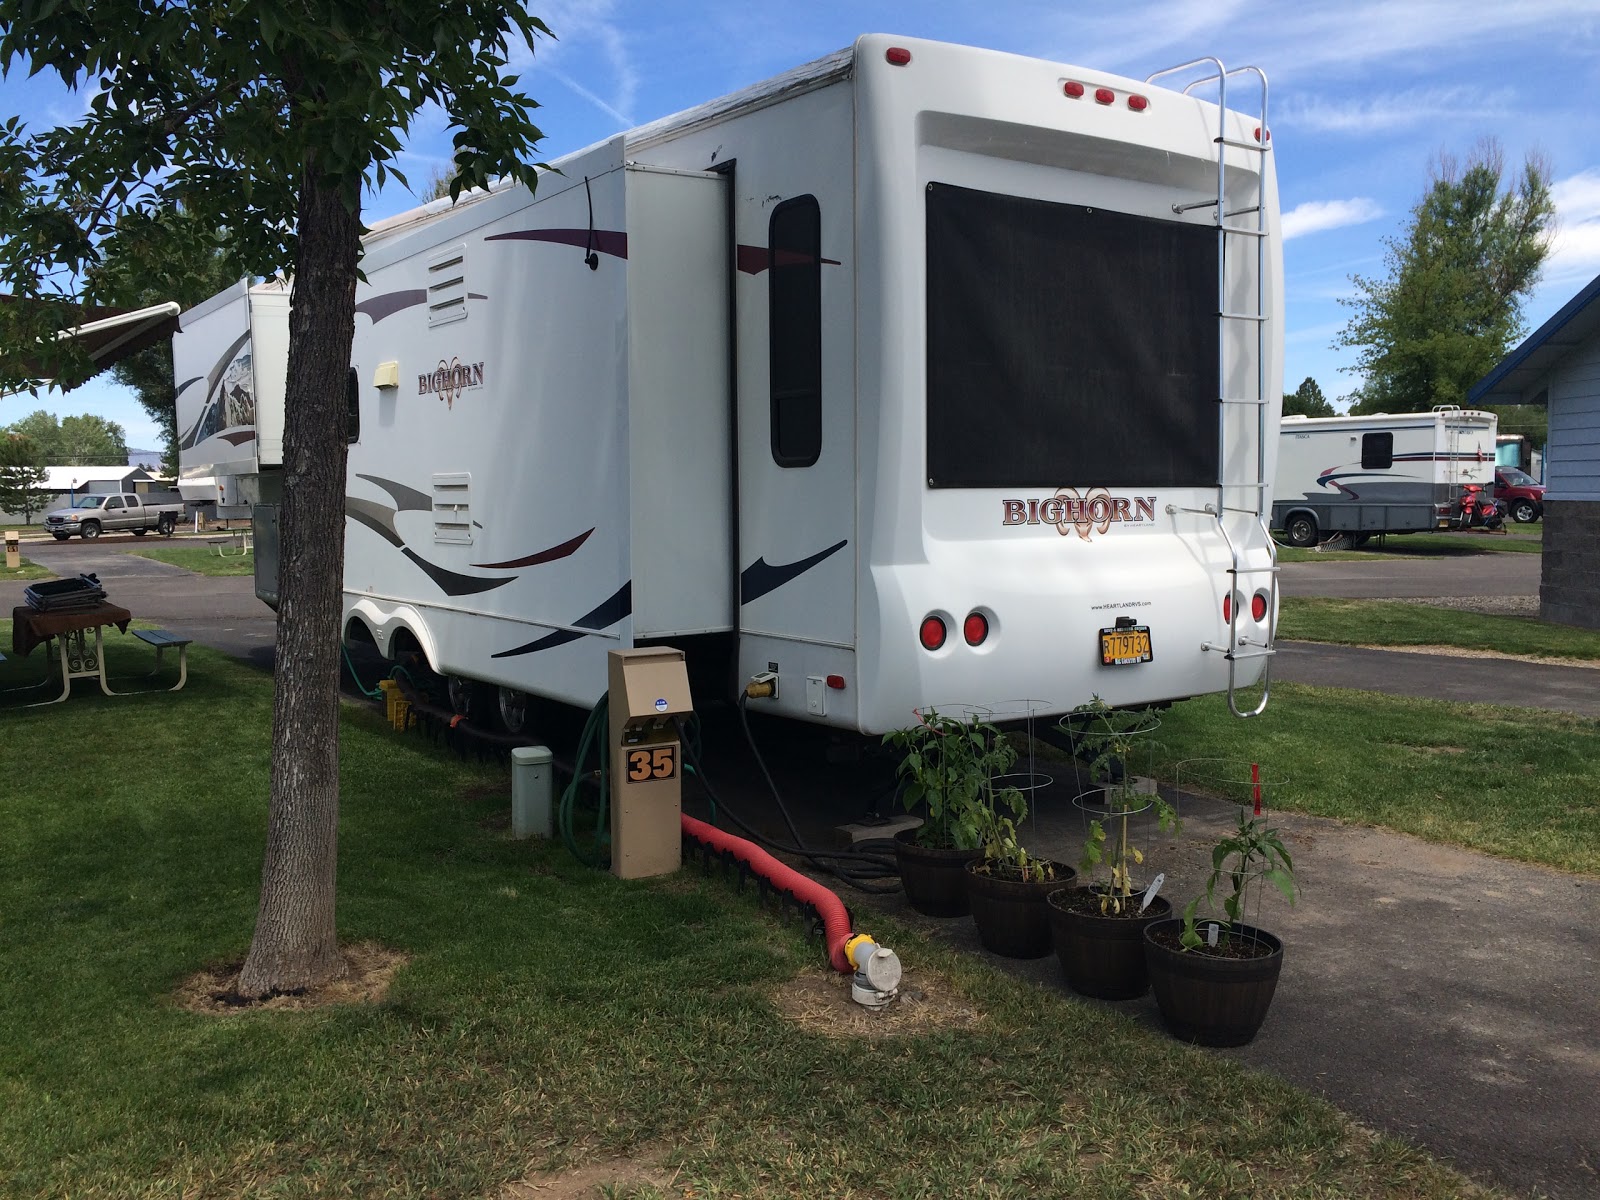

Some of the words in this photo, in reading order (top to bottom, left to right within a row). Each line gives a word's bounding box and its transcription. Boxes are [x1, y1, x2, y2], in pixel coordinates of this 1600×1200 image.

[418, 361, 484, 395] BIGHORN
[1002, 496, 1157, 526] BIGHORN
[1091, 601, 1152, 610] www.HEARTLANDRVS.com
[1103, 634, 1150, 656] R779732
[629, 748, 674, 781] 35
